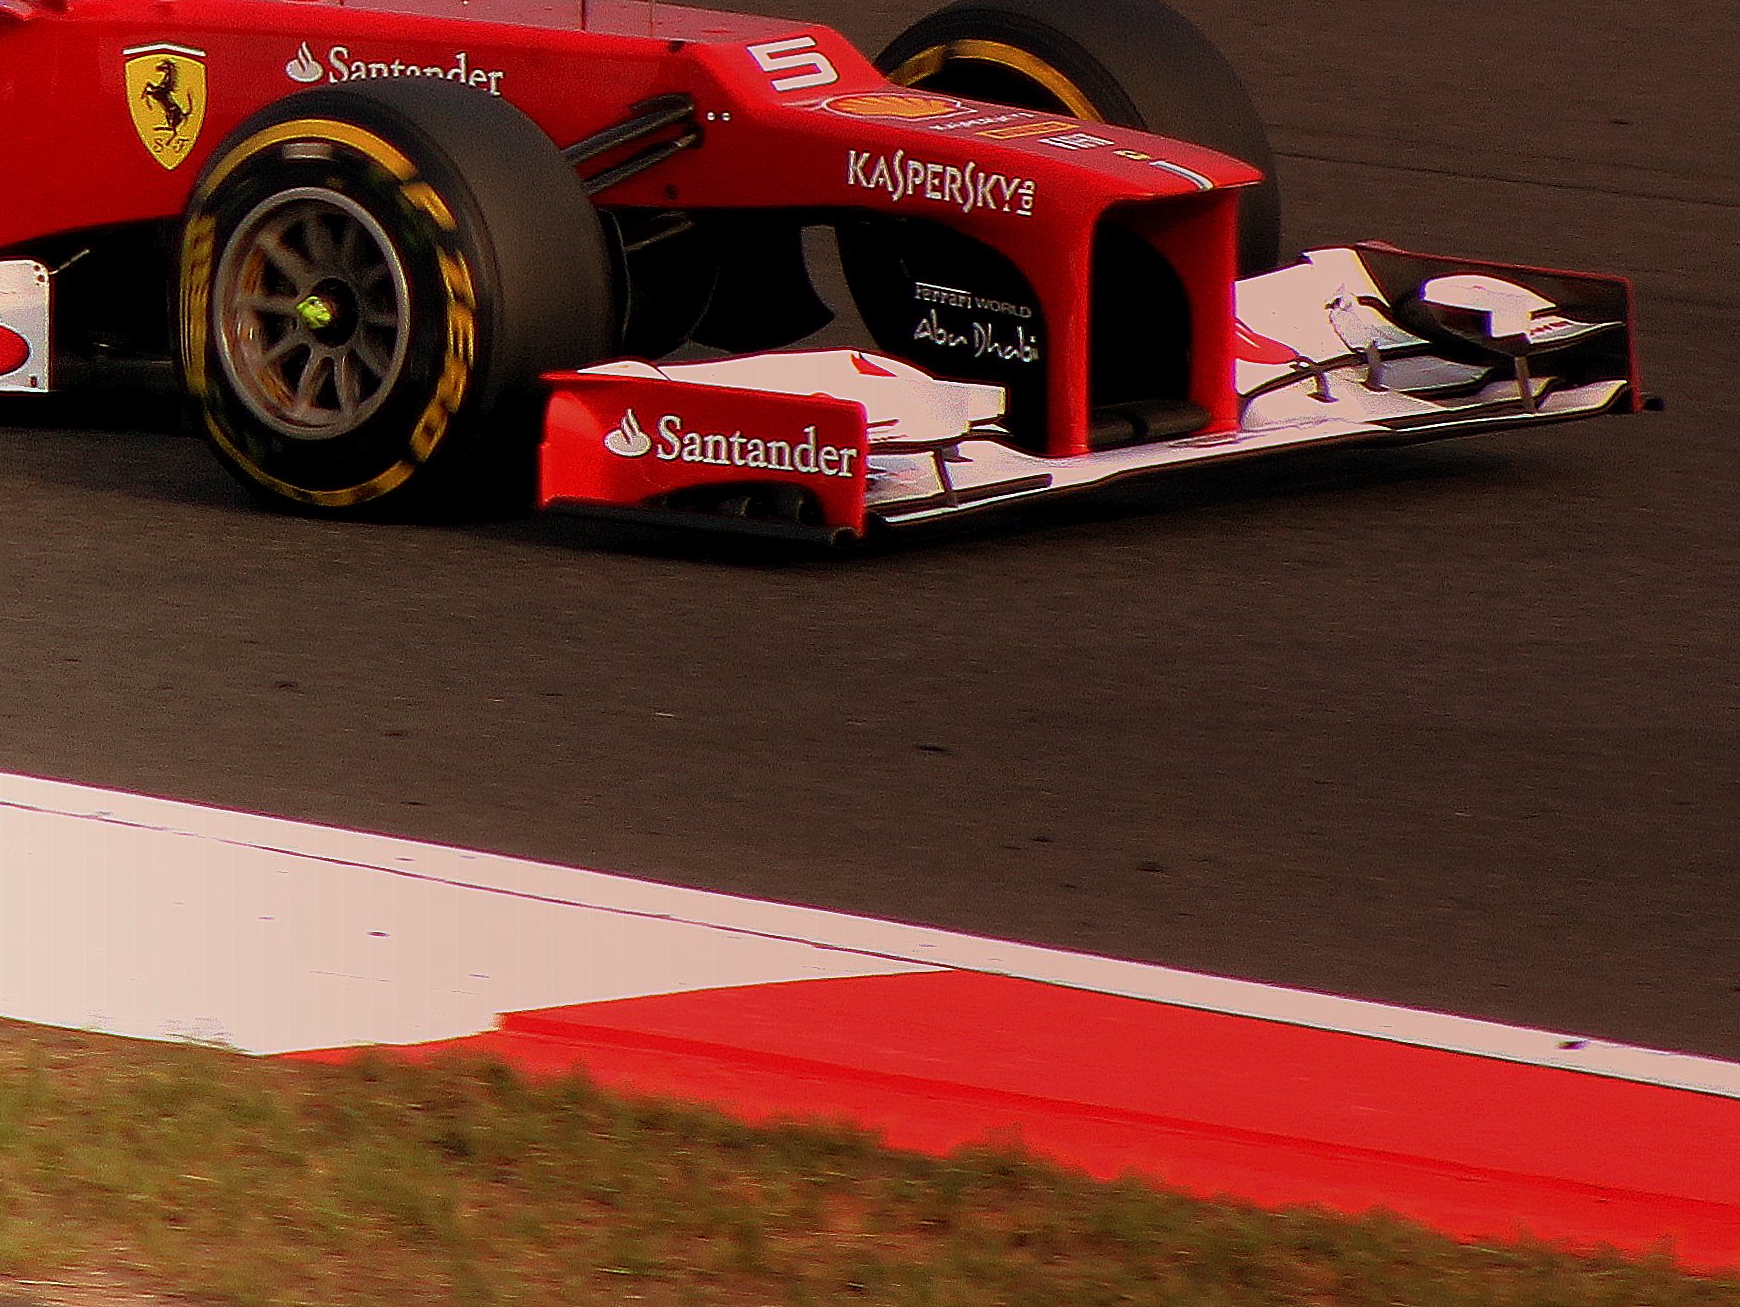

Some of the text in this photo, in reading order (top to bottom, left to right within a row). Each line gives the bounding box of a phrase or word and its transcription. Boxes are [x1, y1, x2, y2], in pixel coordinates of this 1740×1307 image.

[746, 35, 840, 92] 5
[847, 149, 1021, 214] KASPERSKY
[974, 296, 1032, 318] WORLD
[656, 414, 858, 477] Santander
